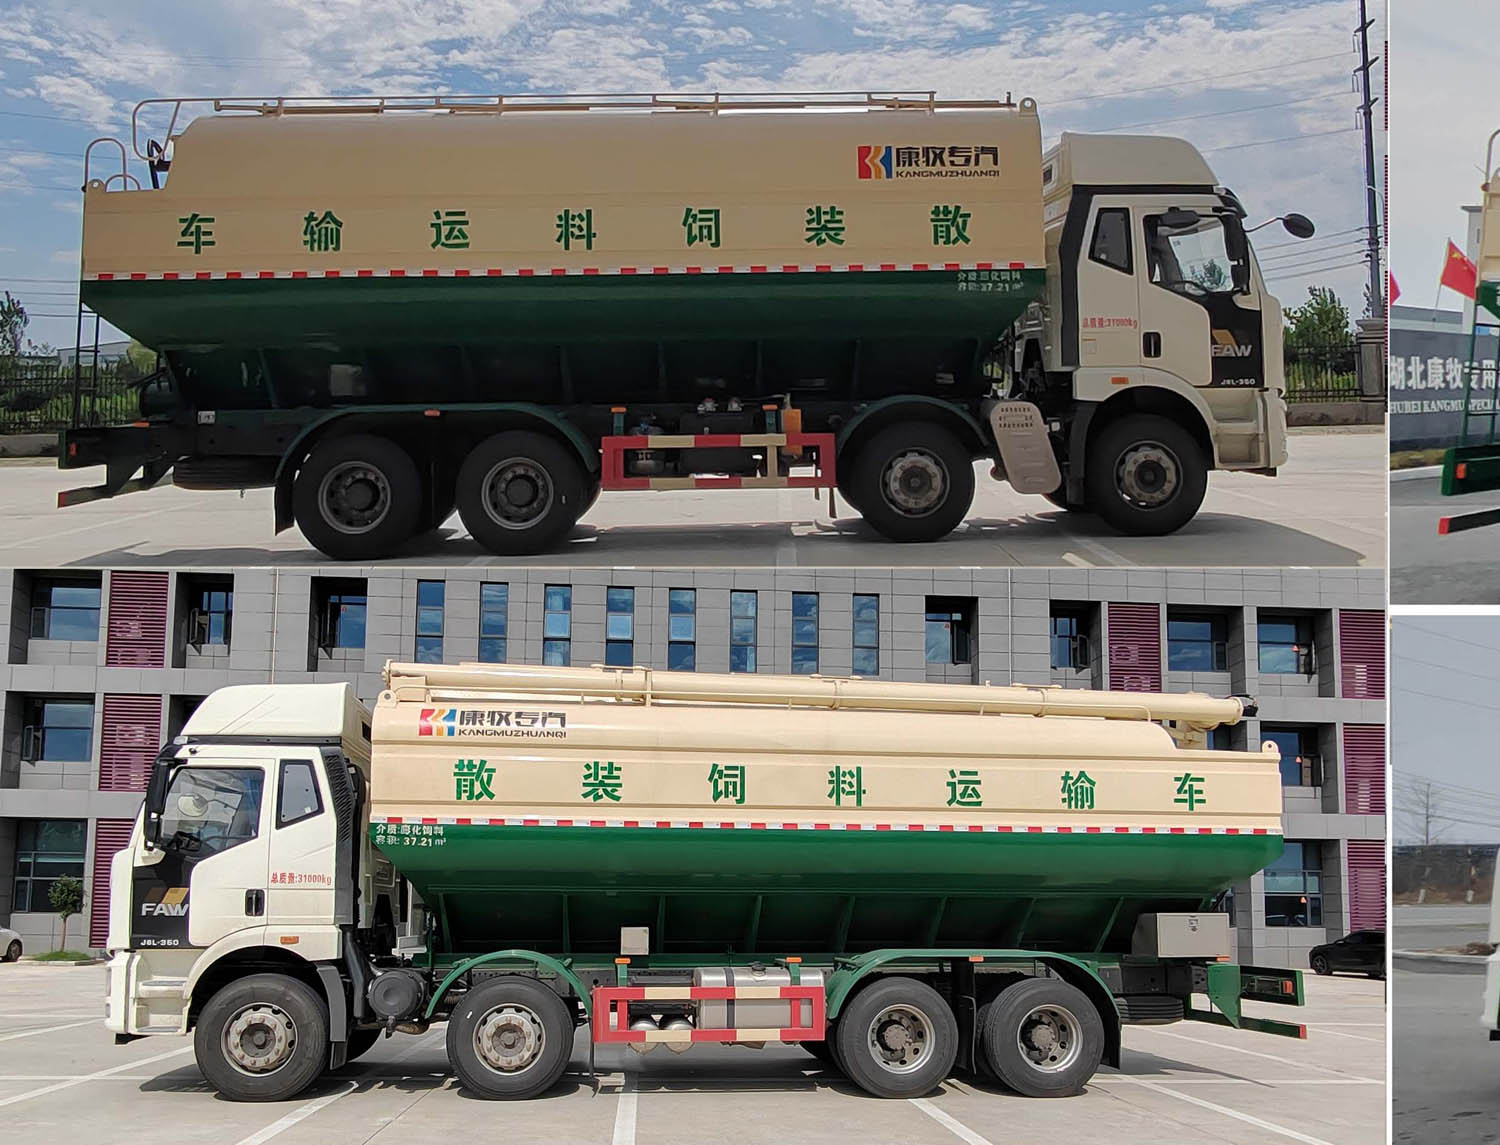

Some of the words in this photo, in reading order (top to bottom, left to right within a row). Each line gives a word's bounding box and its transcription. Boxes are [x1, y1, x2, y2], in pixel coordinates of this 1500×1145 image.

[1212, 344, 1252, 357] FAW
[459, 729, 567, 739] KANGMUZHUANQI
[404, 837, 432, 847] 37.21
[142, 903, 189, 916] FAW
